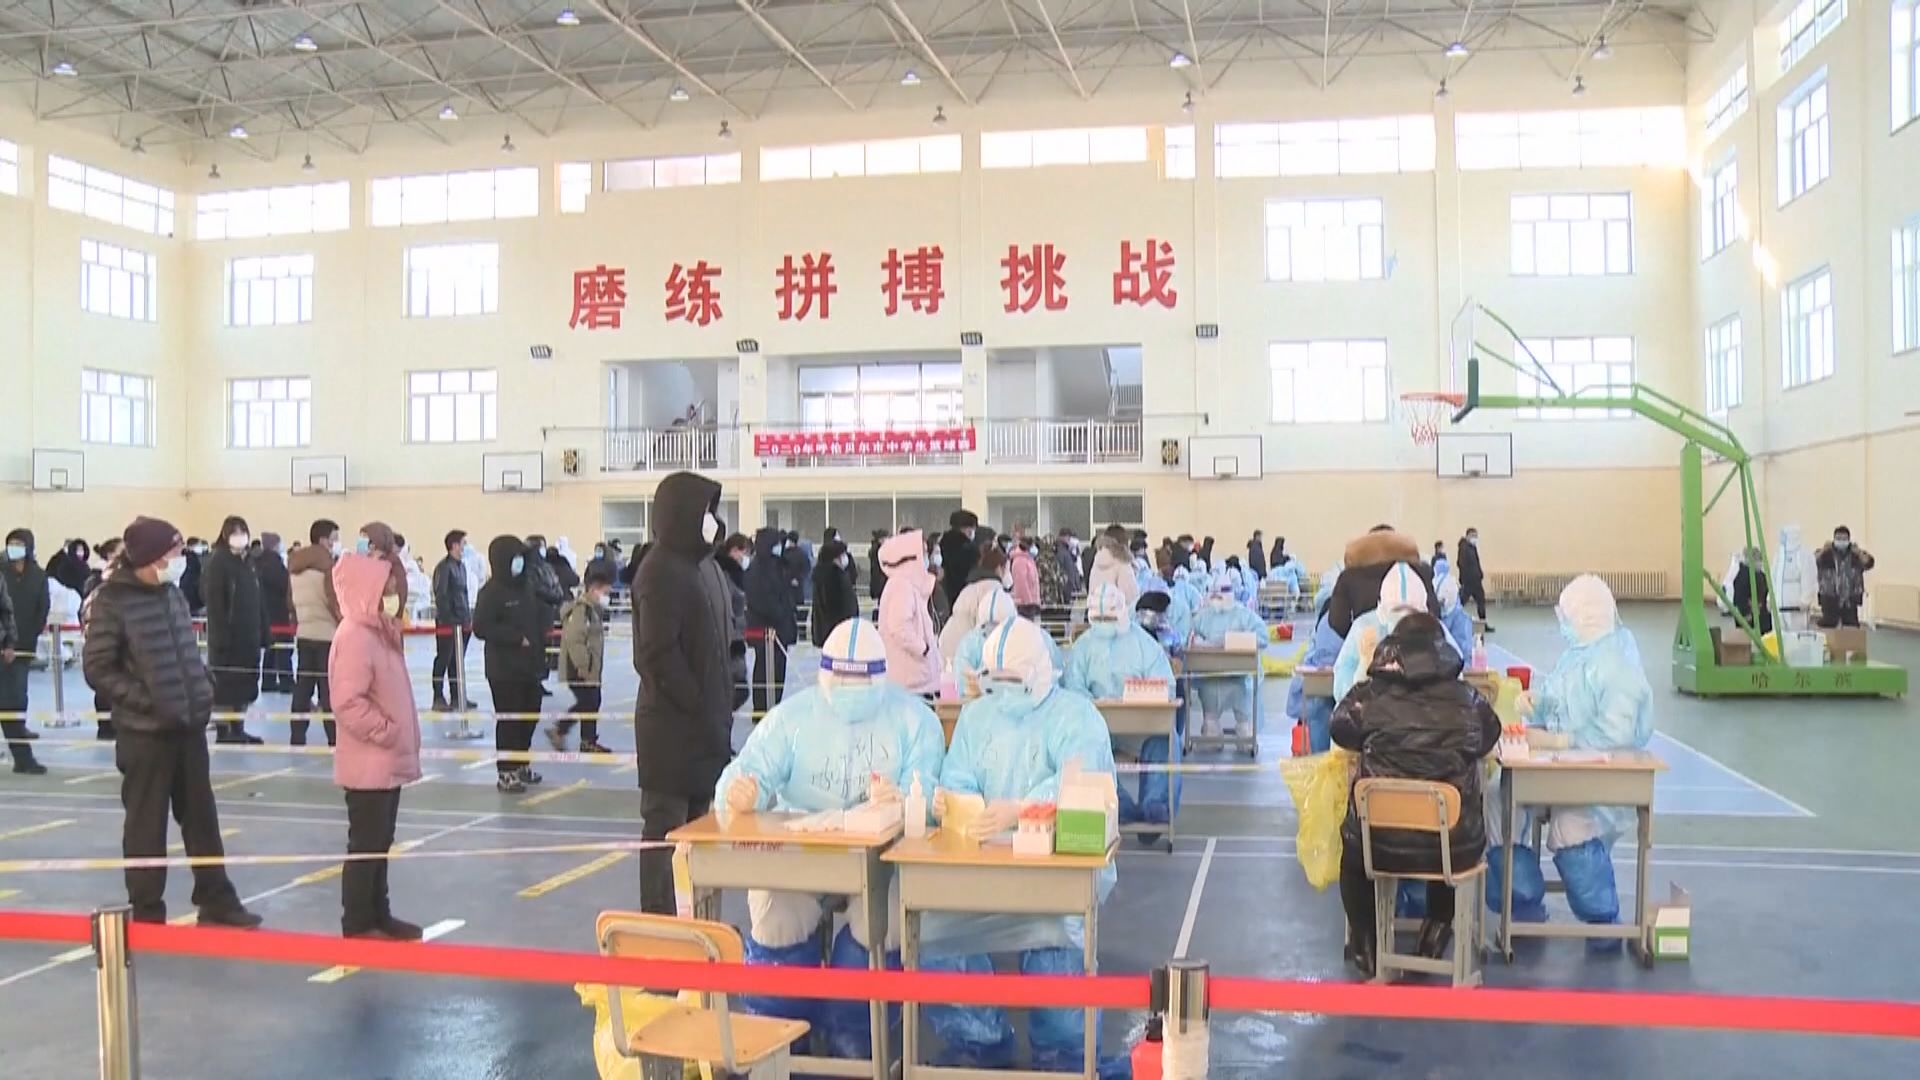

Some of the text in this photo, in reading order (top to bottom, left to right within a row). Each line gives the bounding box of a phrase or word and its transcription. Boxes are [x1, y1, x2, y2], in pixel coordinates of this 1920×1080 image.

[569, 239, 1178, 329] 磨练拼搏挑战
